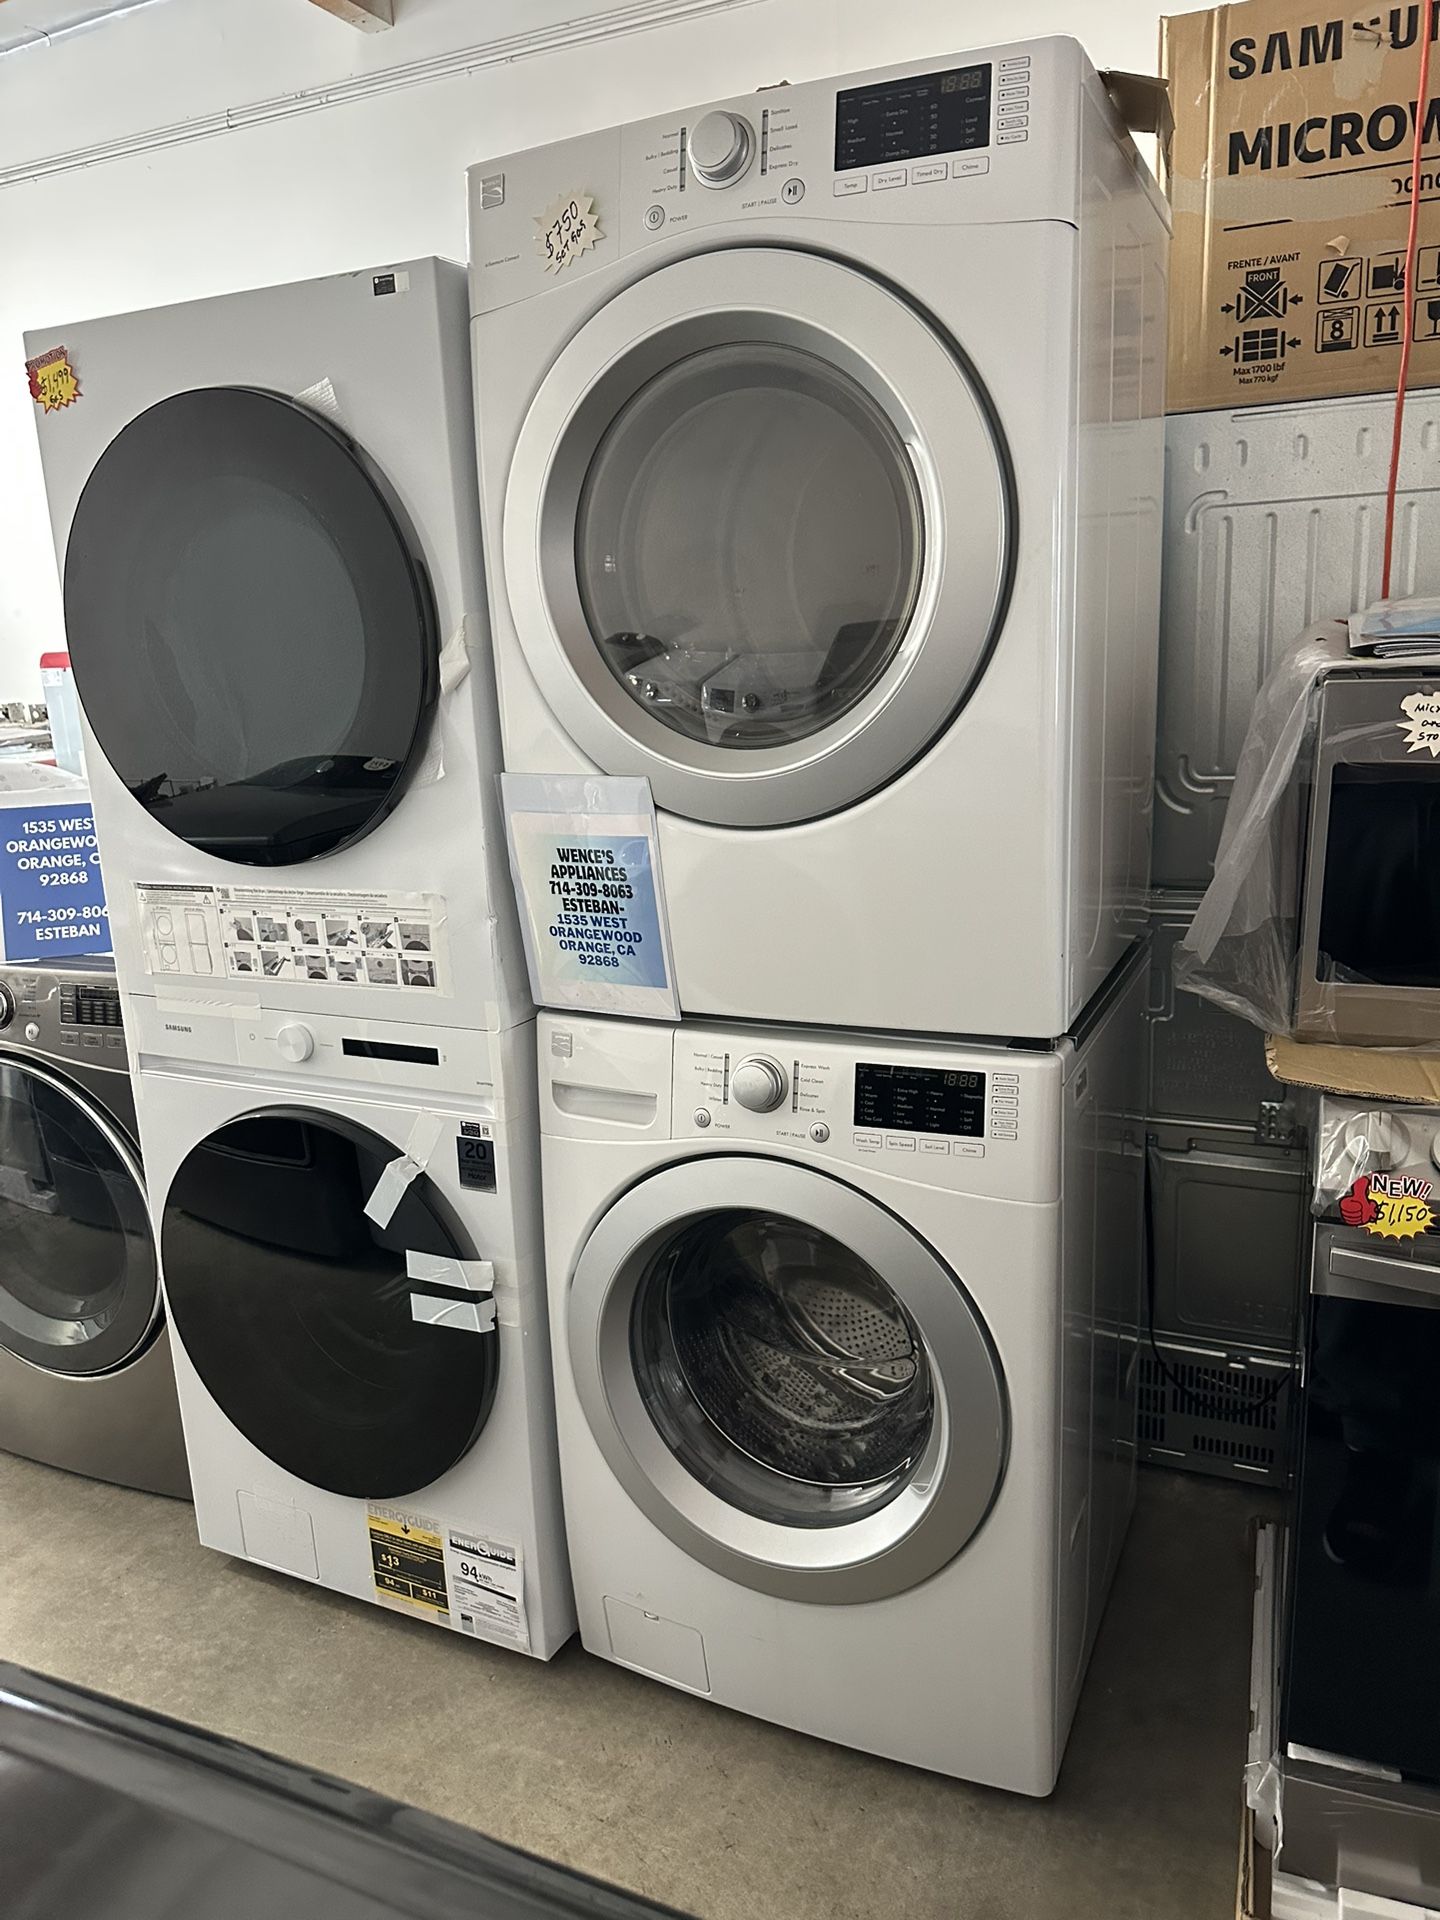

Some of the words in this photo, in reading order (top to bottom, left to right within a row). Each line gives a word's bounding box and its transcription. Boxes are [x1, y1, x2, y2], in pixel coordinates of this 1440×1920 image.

[933, 168, 943, 176] Dry
[742, 201, 757, 209] START
[546, 201, 578, 259] $750
[1228, 257, 1262, 271] FRENTE
[1269, 252, 1301, 265] AVANT
[1248, 271, 1279, 283] FRONT
[1330, 319, 1344, 341] 8
[1233, 367, 1251, 376] Max
[1252, 364, 1272, 374] 1700
[1273, 362, 1286, 372] lbf
[1239, 377, 1253, 385] Max
[1254, 375, 1267, 383] 770
[1267, 374, 1279, 383] kgf
[22, 820, 56, 835] 1535
[59, 817, 95, 832] WES
[6, 835, 97, 853] ORANGEWO
[17, 854, 86, 871] ORANGE,
[556, 848, 615, 865] WENCE'S
[39, 871, 89, 887] 92868
[551, 865, 628, 882] APPLIANCES
[549, 880, 634, 899] 714-309-8063
[562, 898, 625, 915] ESTEBAN-
[557, 914, 589, 926] 1535
[590, 915, 628, 929] WEST
[35, 924, 101, 941] ESTEBAN
[549, 925, 643, 944] ORANGEWOOD
[559, 939, 616, 956] ORANGE,
[618, 943, 636, 957] CA
[579, 954, 620, 968] 92868
[165, 1023, 193, 1034] SAMSUNG
[464, 1141, 487, 1160] 20
[1372, 1174, 1433, 1200] NEW!
[1375, 1201, 1427, 1226] $1,150
[381, 1553, 400, 1569] $13
[460, 1562, 479, 1582] 94
